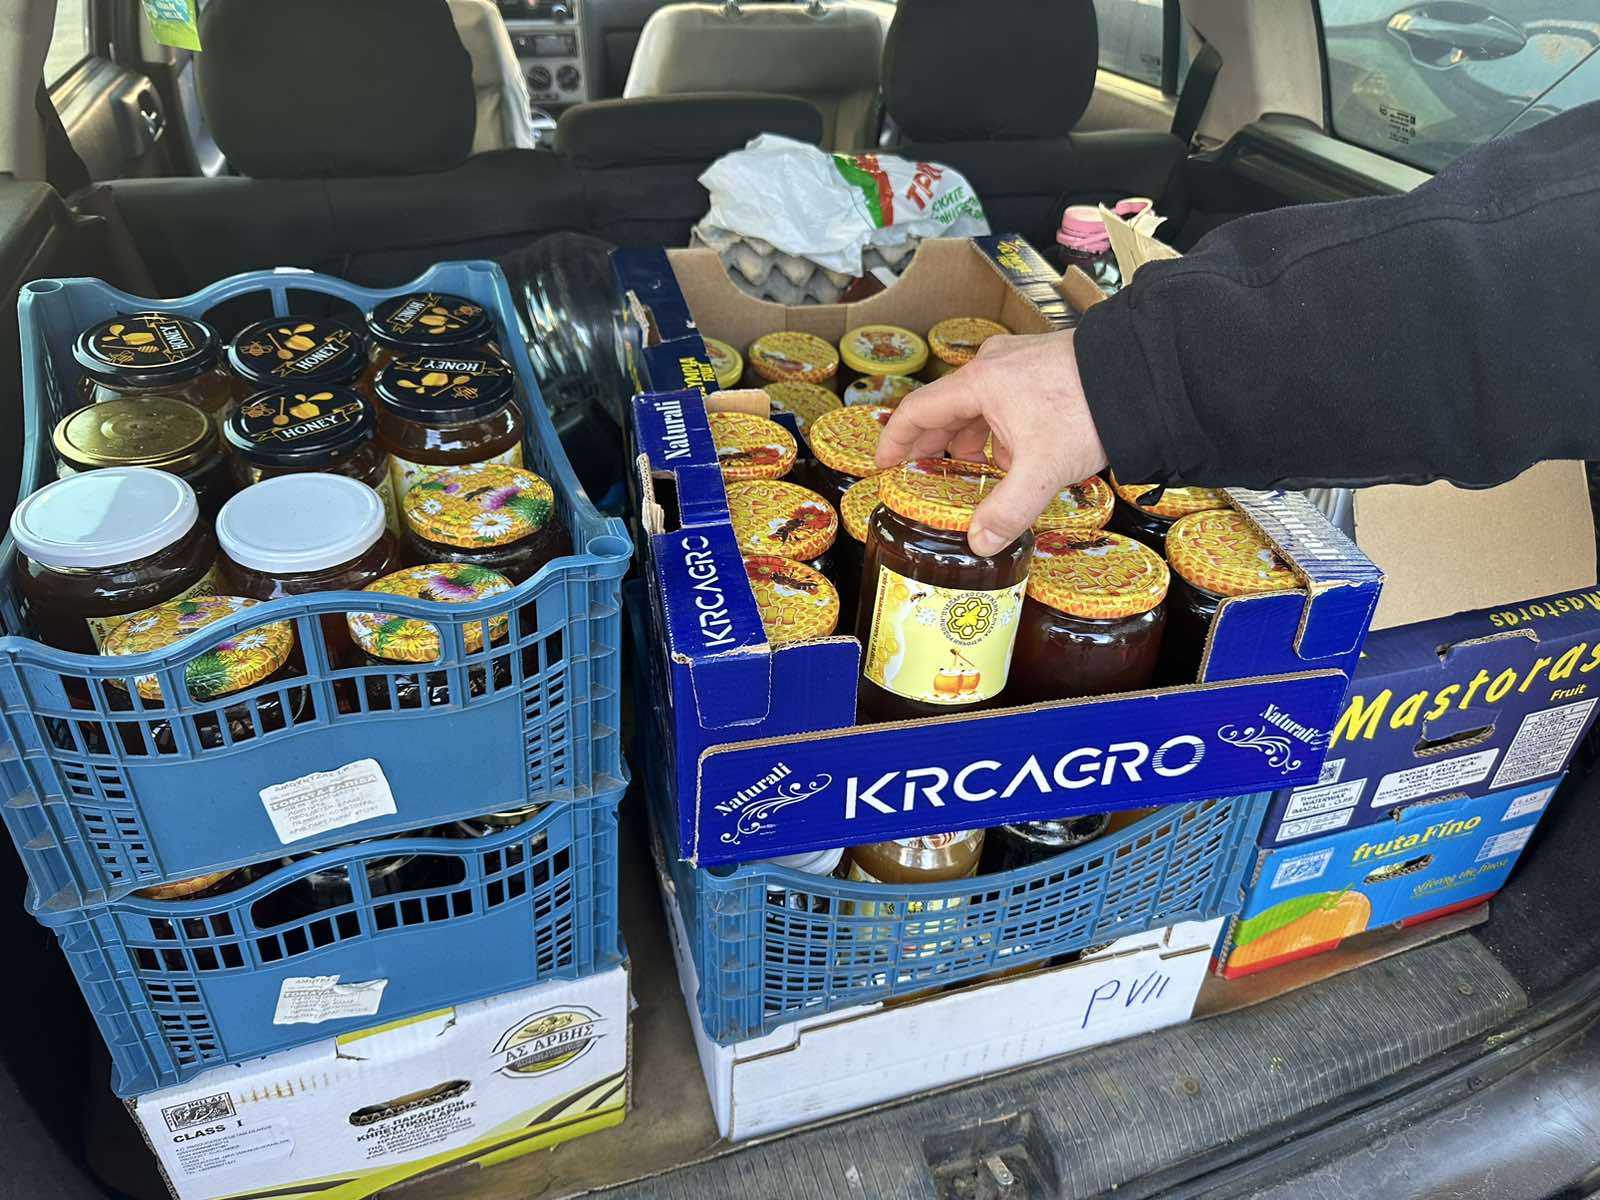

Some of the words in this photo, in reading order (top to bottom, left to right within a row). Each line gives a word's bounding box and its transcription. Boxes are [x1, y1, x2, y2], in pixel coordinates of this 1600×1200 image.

[394, 301, 425, 323] HONEY
[160, 325, 189, 350] HONEY
[296, 344, 340, 370] HONEY
[424, 360, 480, 372] HONEY
[282, 415, 338, 438] HONEY
[653, 400, 692, 460] Naturali
[1328, 642, 1600, 749] Mastoras
[1550, 683, 1587, 701] Fruit
[1258, 703, 1319, 743] Naturali
[714, 762, 792, 816] Naturali
[845, 734, 1206, 819] KRCAGRO
[505, 1044, 528, 1063] ΑΣ
[533, 1023, 595, 1052] ΑΡΒΗΣ
[173, 1124, 227, 1143] CLASS
